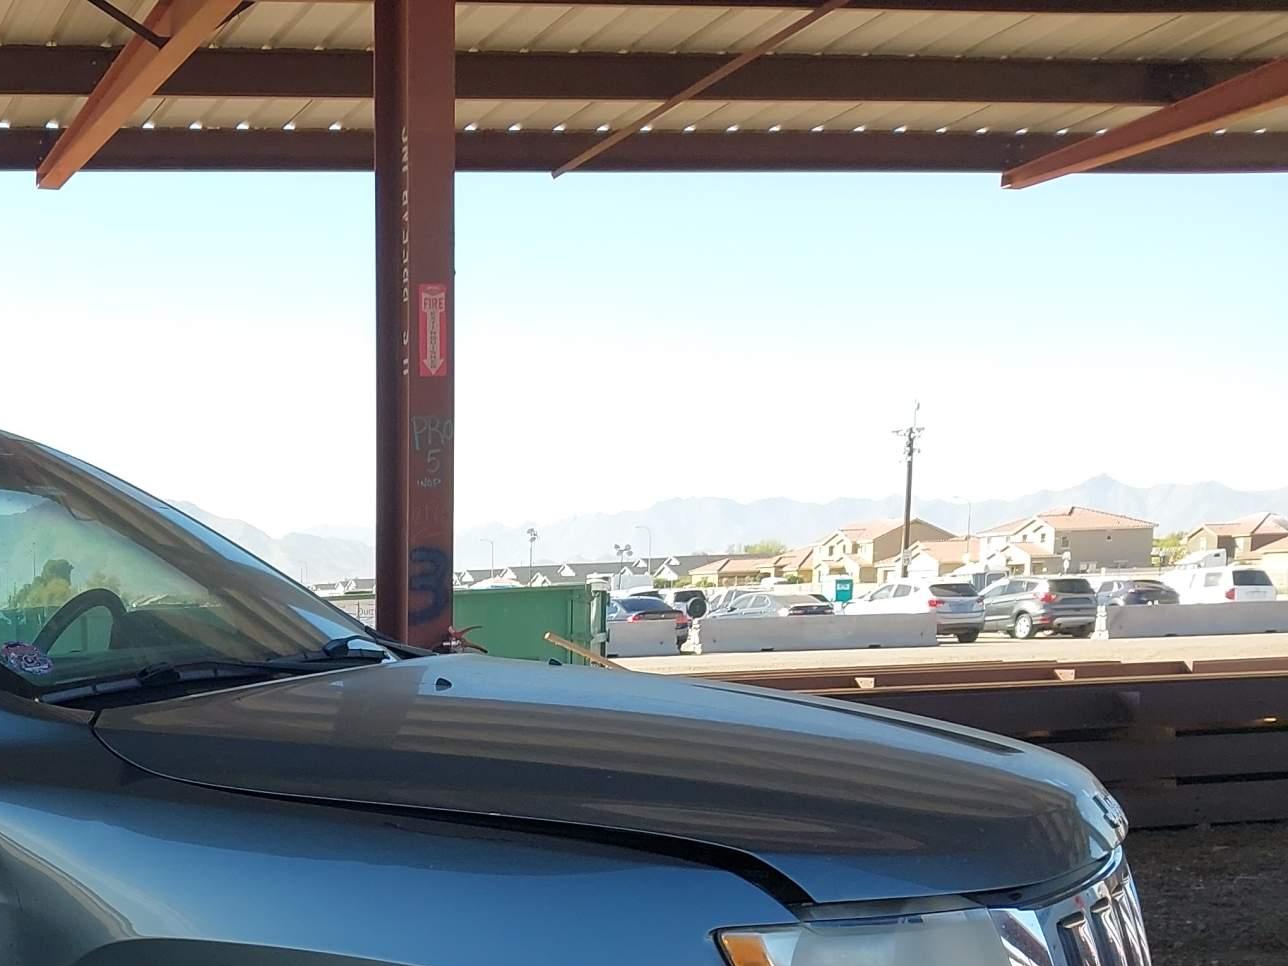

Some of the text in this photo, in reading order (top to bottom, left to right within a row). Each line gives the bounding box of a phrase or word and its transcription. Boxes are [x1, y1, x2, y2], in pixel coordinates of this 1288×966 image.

[423, 297, 444, 310] FIRE
[426, 448, 441, 473] 5
[407, 544, 450, 626] 3
